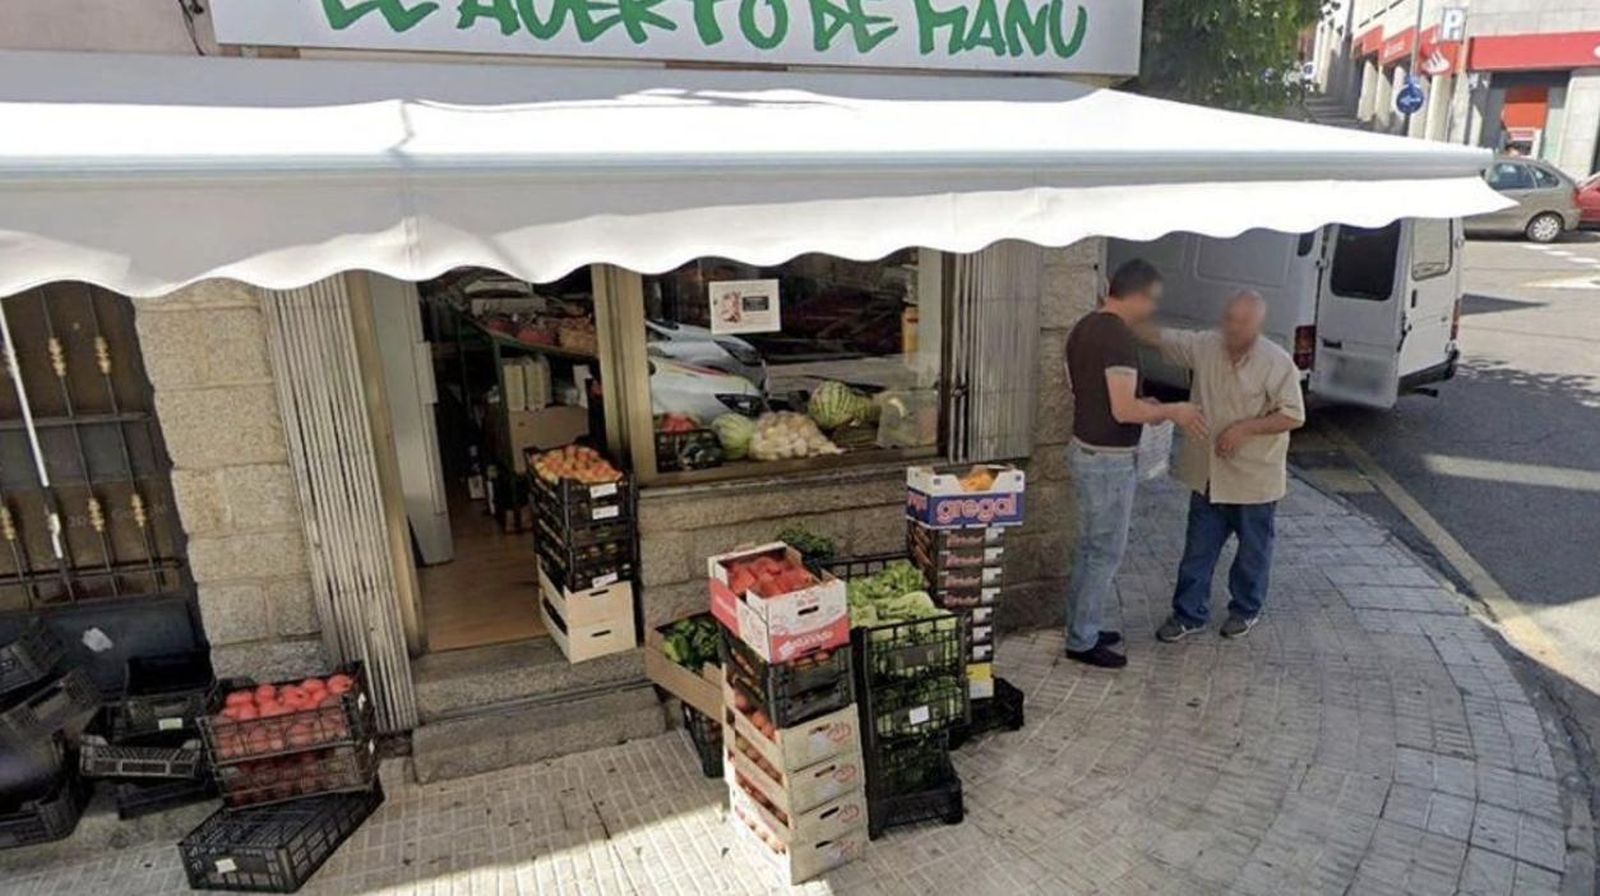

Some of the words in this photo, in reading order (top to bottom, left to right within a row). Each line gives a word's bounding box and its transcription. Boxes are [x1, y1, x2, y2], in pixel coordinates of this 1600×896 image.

[811, 0, 898, 53] DE
[914, 0, 1087, 58] MANU
[936, 493, 1018, 524] gregal
